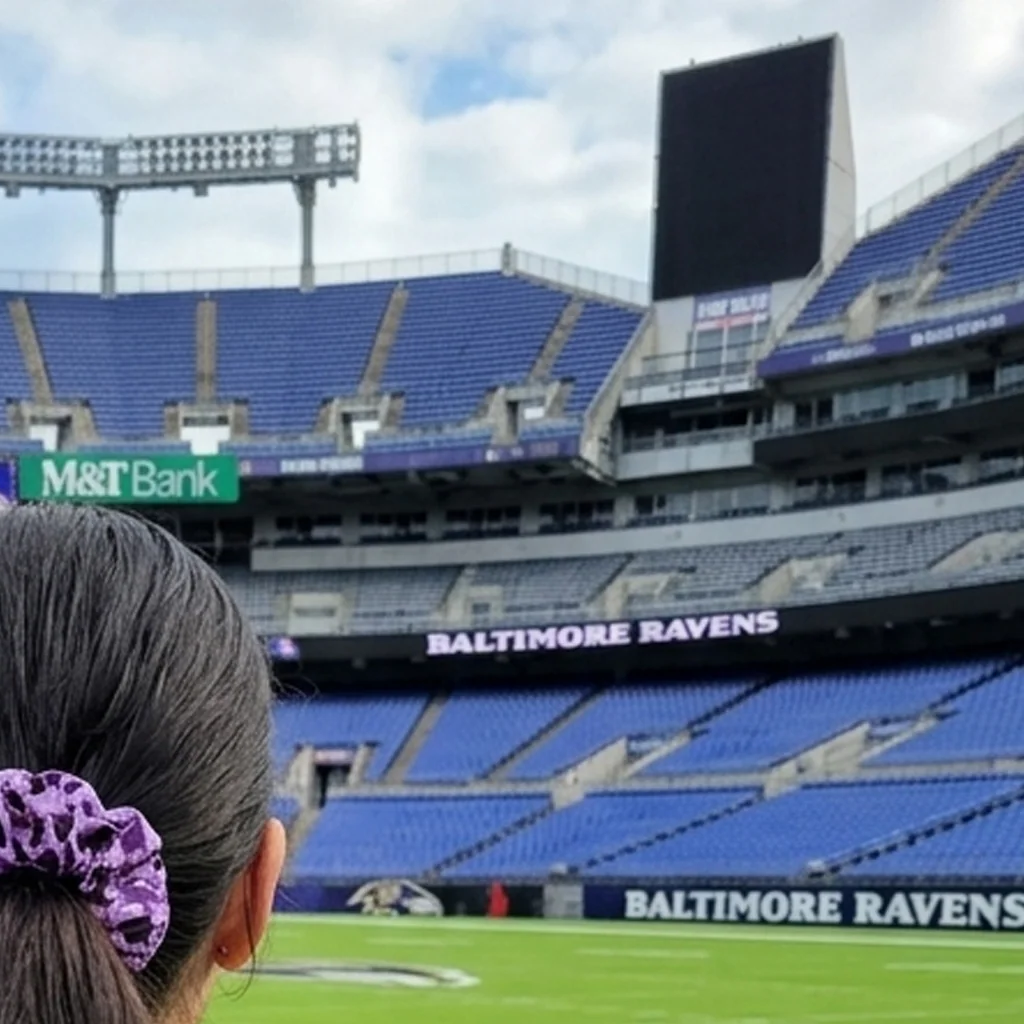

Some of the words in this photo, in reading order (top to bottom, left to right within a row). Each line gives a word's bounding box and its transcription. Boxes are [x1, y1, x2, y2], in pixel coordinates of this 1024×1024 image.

[41, 459, 129, 496] M&T
[131, 459, 219, 497] Bank
[427, 623, 631, 655] BALTIMORE
[638, 610, 780, 643] RAVENS
[624, 890, 842, 923] BALTIMORE
[853, 891, 1024, 928] RAVENS
